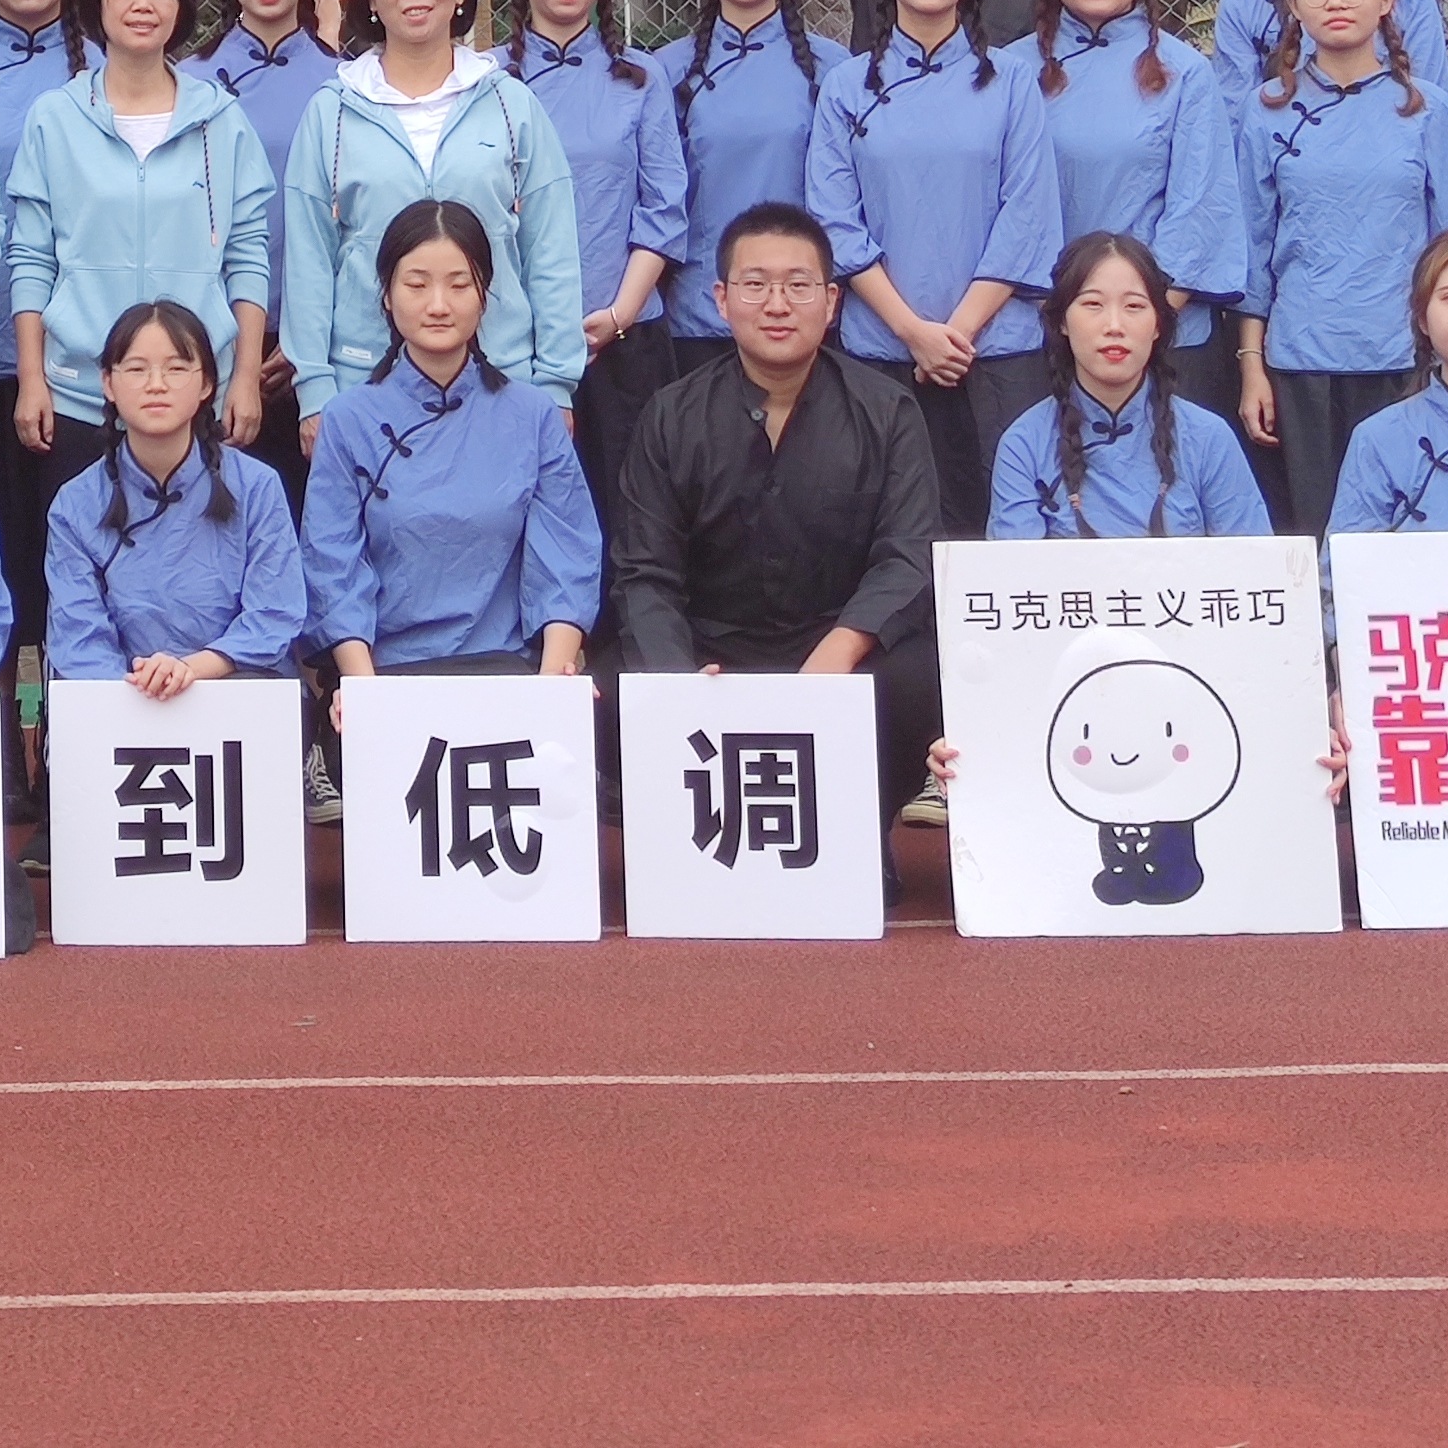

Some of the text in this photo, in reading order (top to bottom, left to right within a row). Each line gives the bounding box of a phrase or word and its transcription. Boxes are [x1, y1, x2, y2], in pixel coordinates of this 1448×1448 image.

[963, 587, 1286, 631] 马克思主义乖巧
[113, 739, 246, 882] 到
[404, 735, 544, 878] 低
[682, 728, 820, 871] 调
[1381, 820, 1440, 841] Reliable
